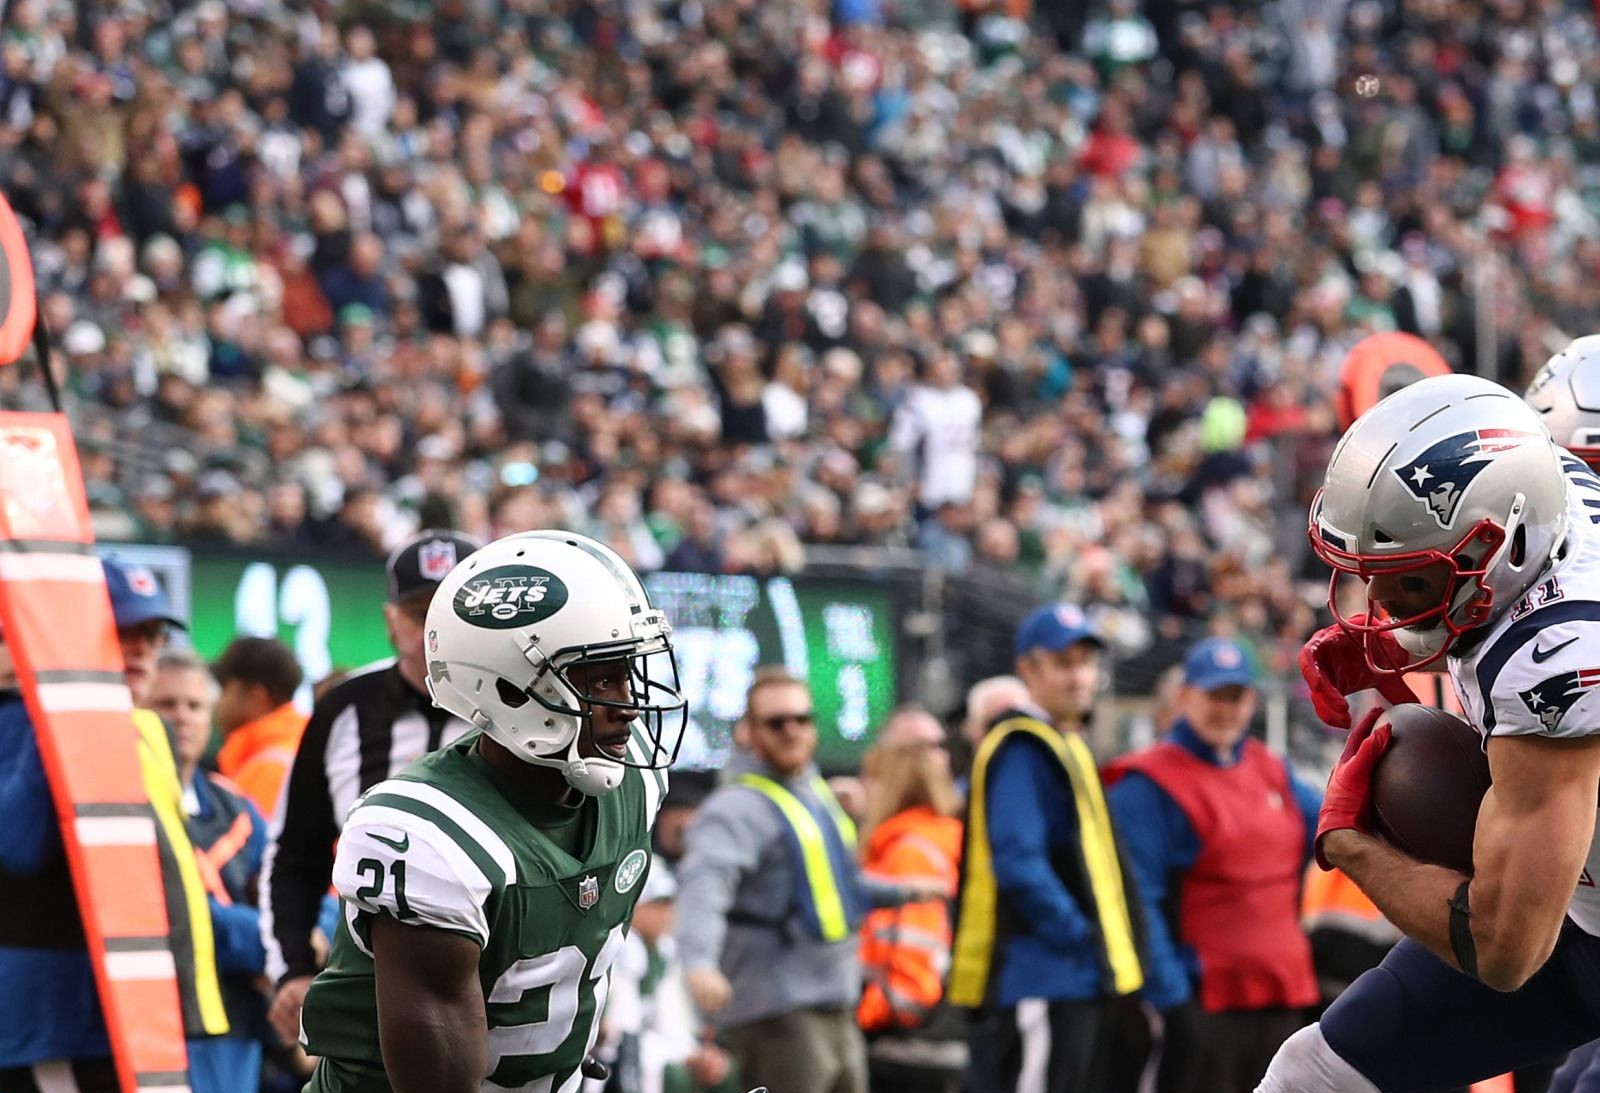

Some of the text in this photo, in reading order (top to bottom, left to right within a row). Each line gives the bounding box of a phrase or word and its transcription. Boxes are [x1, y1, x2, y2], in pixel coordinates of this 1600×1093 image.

[462, 585, 548, 608] JETS
[1511, 576, 1564, 622] 11
[356, 858, 418, 919] 21
